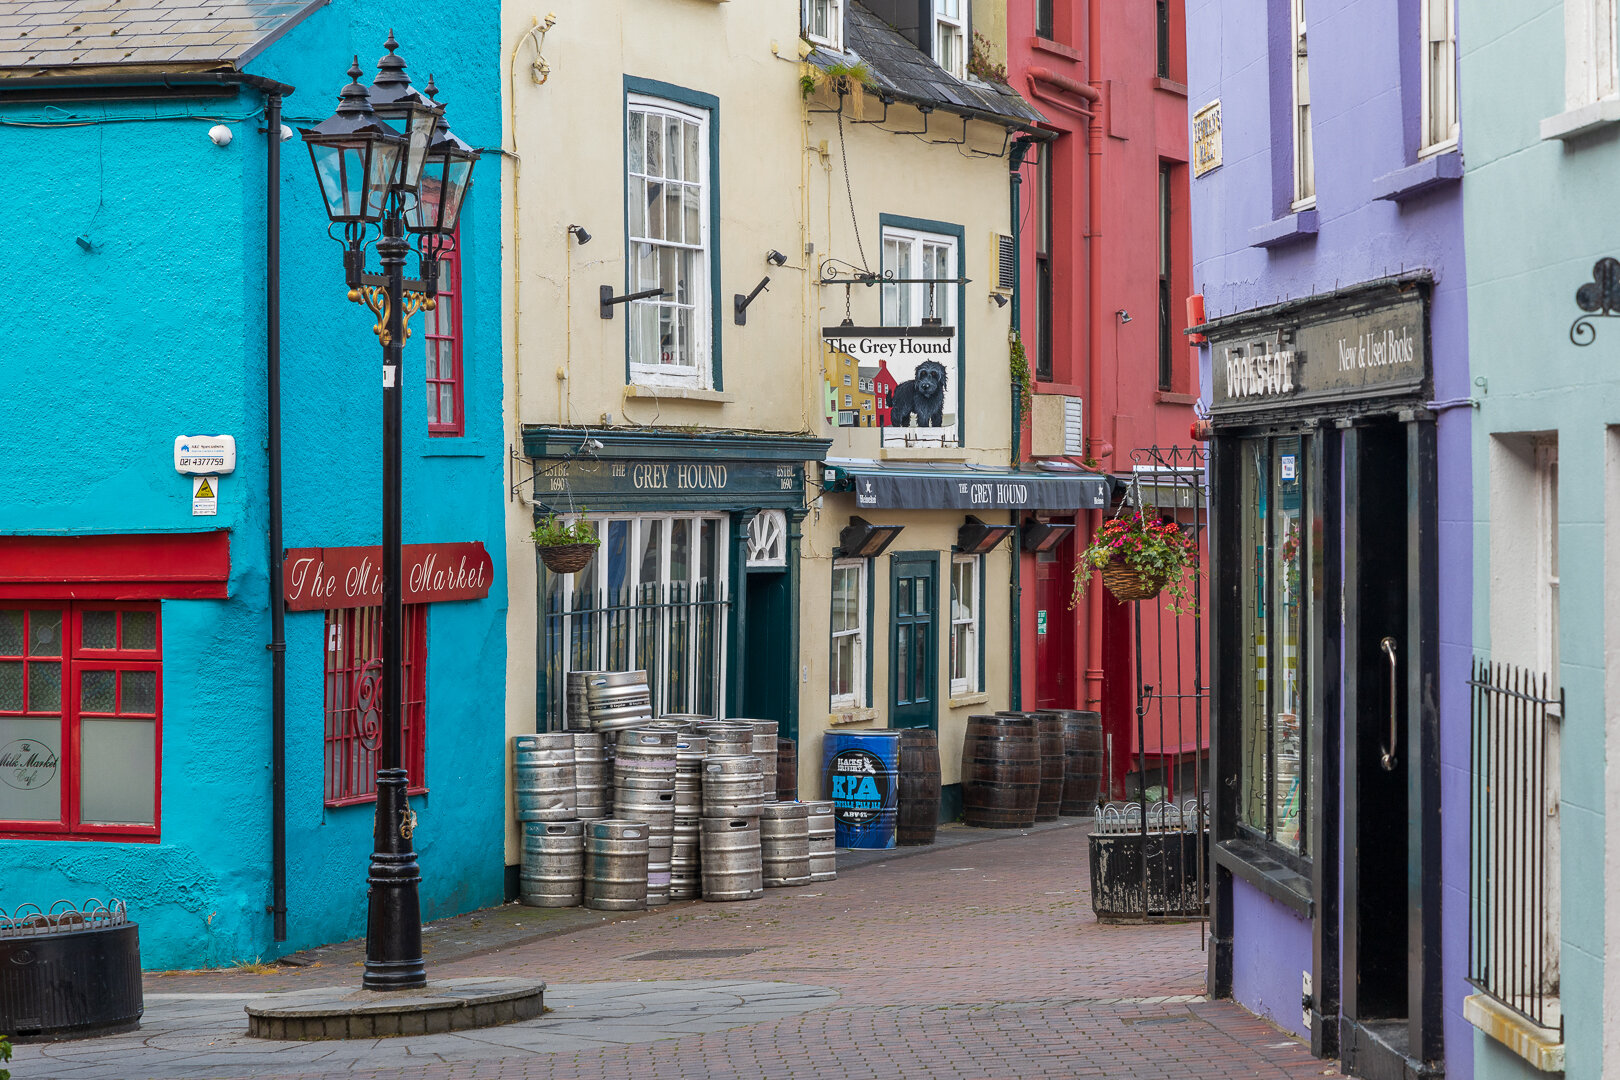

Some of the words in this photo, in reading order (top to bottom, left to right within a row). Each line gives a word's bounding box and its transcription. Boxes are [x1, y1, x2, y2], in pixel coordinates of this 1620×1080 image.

[826, 338, 856, 354] The
[859, 338, 896, 357] Grey
[899, 338, 952, 354] Hound
[1339, 339, 1357, 371] New
[1358, 335, 1366, 368] &
[1366, 330, 1387, 367] Used
[1388, 326, 1413, 363] Books
[192, 458, 224, 466] 4377759
[550, 478, 565, 491] 1690
[612, 464, 626, 477] THE
[633, 464, 670, 489] GREY
[677, 464, 728, 489] HOUND
[780, 478, 793, 490] 1690
[958, 483, 968, 494] THE
[970, 484, 993, 504] GREY
[997, 484, 1028, 504] HOUND
[289, 557, 336, 600] The
[345, 556, 383, 597] Mi
[409, 553, 485, 593] Market
[20, 752, 59, 768] Market
[832, 776, 881, 800] KPA
